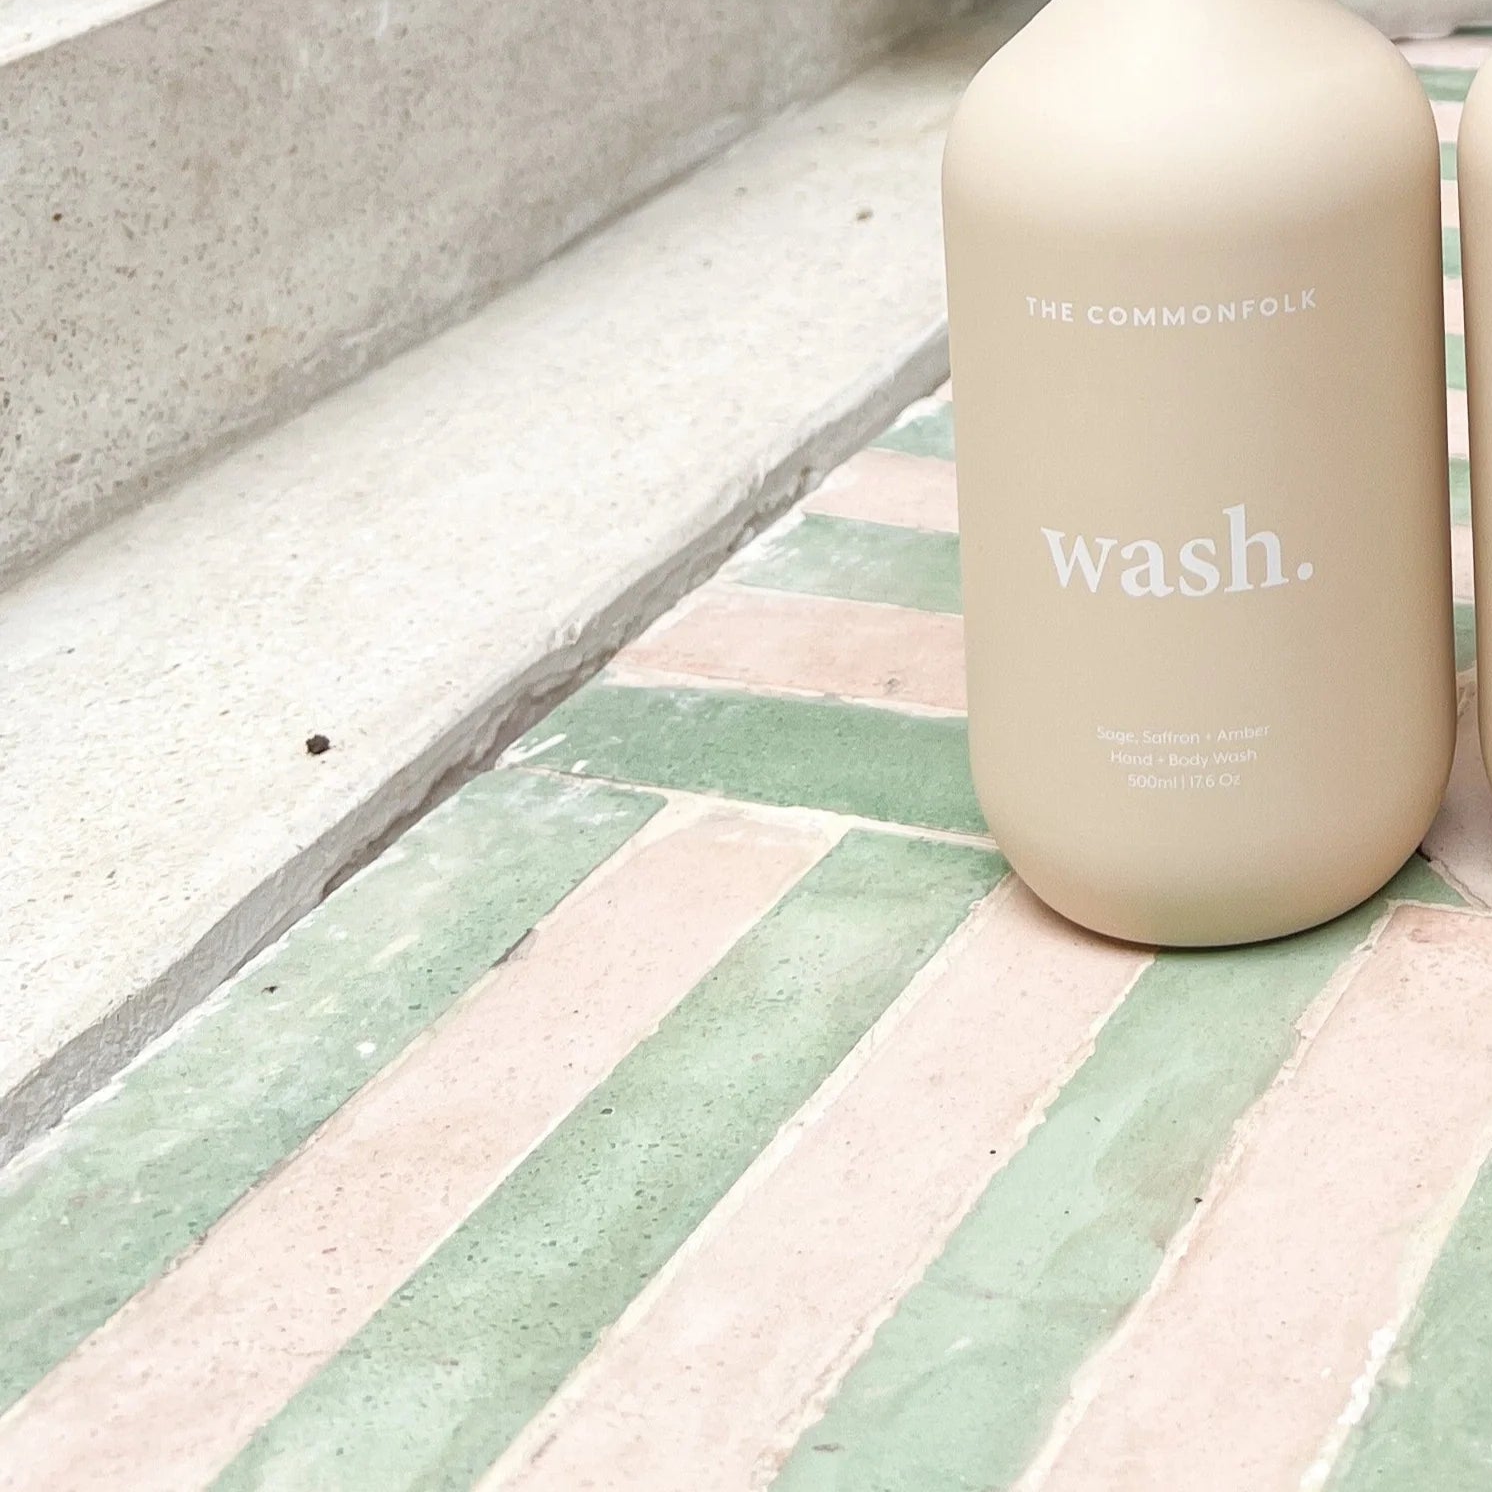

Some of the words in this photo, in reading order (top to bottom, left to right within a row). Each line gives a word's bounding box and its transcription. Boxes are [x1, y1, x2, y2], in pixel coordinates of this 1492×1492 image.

[1026, 296, 1073, 323] THE
[1087, 287, 1317, 326] COMMONFOLK
[1040, 504, 1314, 597] wash.
[1097, 726, 1139, 745] Sage,
[1143, 730, 1200, 744] Saffron
[1217, 725, 1270, 742] Amber
[1111, 750, 1153, 766] Hand
[1169, 753, 1208, 768] Body
[1213, 748, 1257, 764] Wash
[1128, 774, 1177, 789] 500ml
[1219, 773, 1241, 787] Oz
